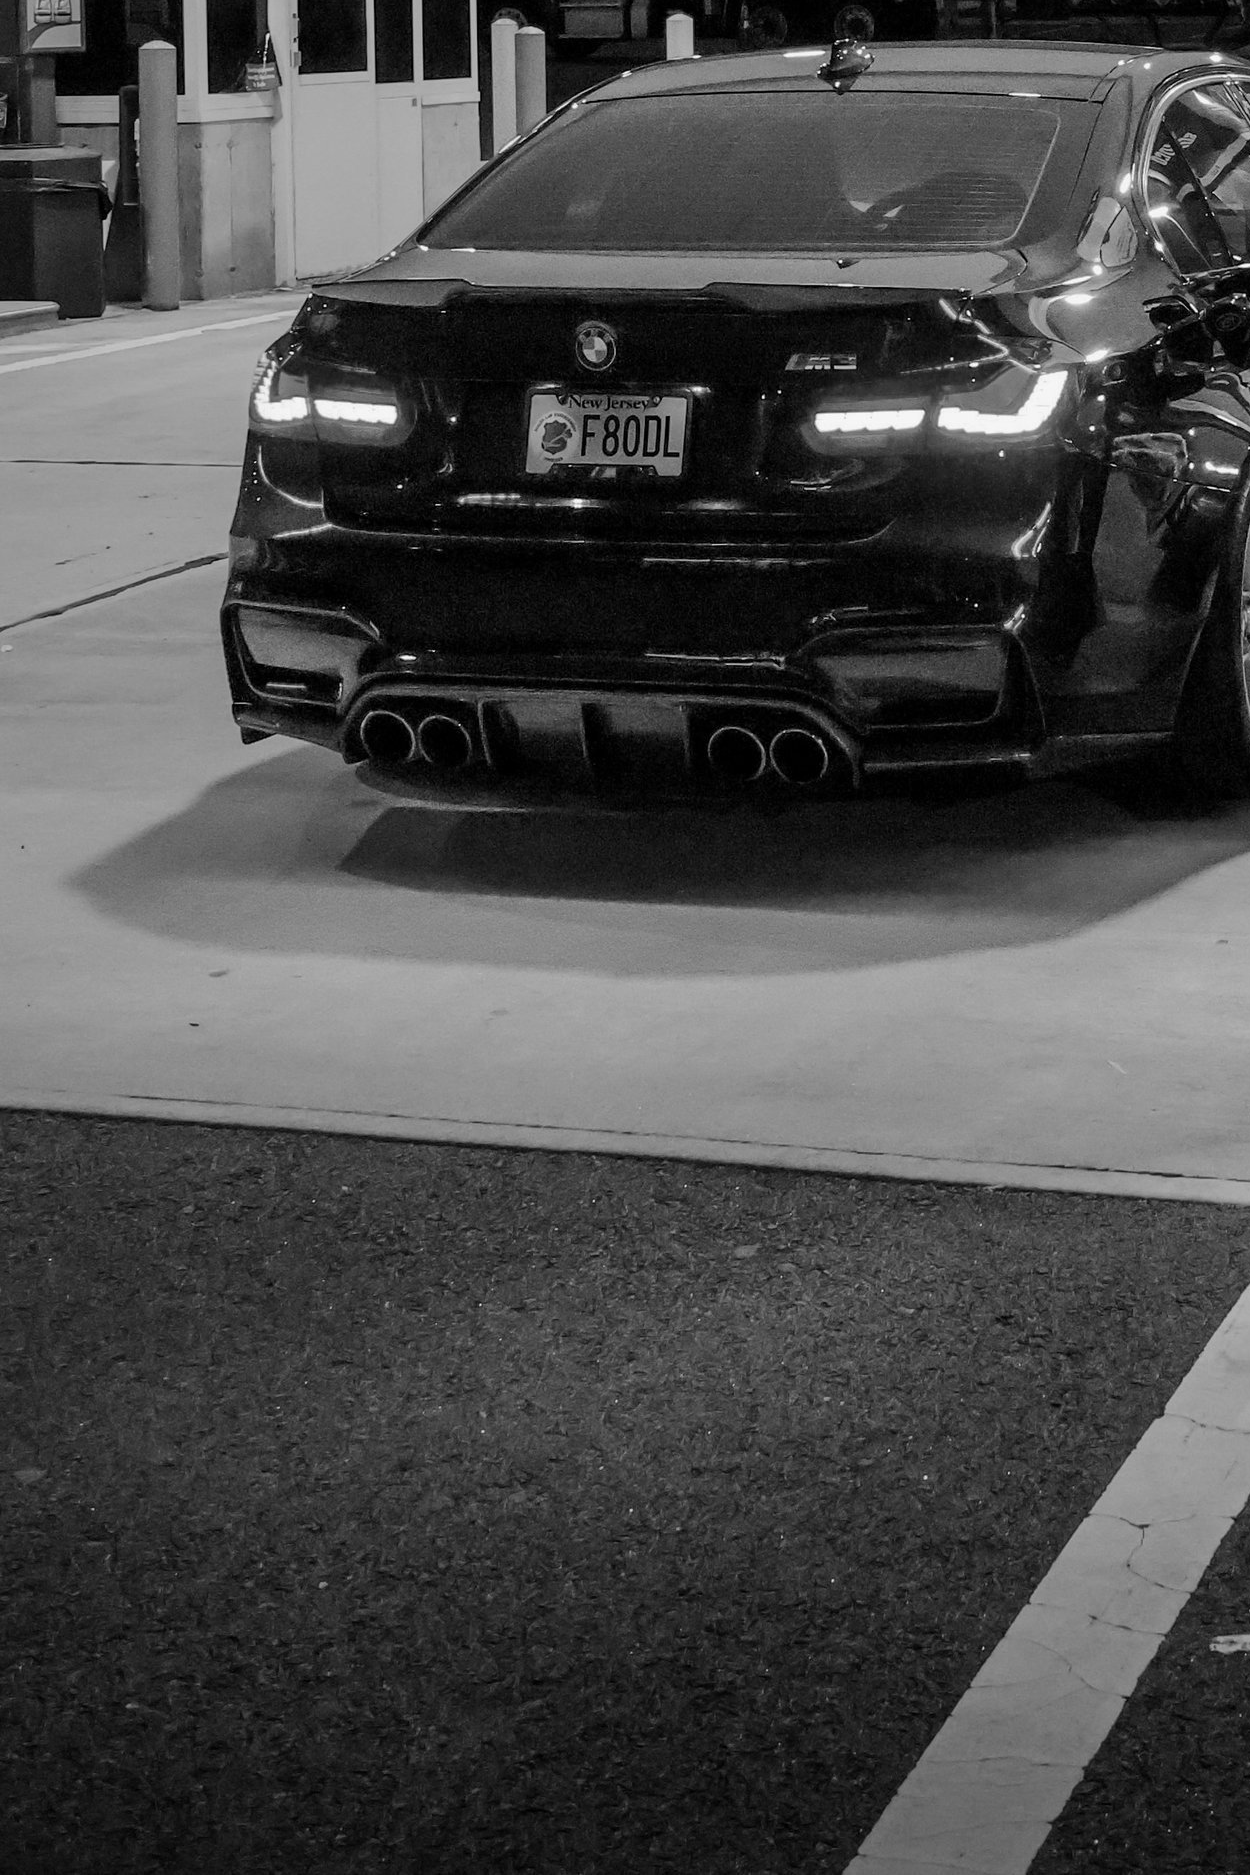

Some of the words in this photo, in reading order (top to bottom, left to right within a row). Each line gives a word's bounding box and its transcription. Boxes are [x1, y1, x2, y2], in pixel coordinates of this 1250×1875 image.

[568, 394, 602, 409] New
[604, 394, 651, 412] Jersey
[580, 414, 680, 458] F80DL
